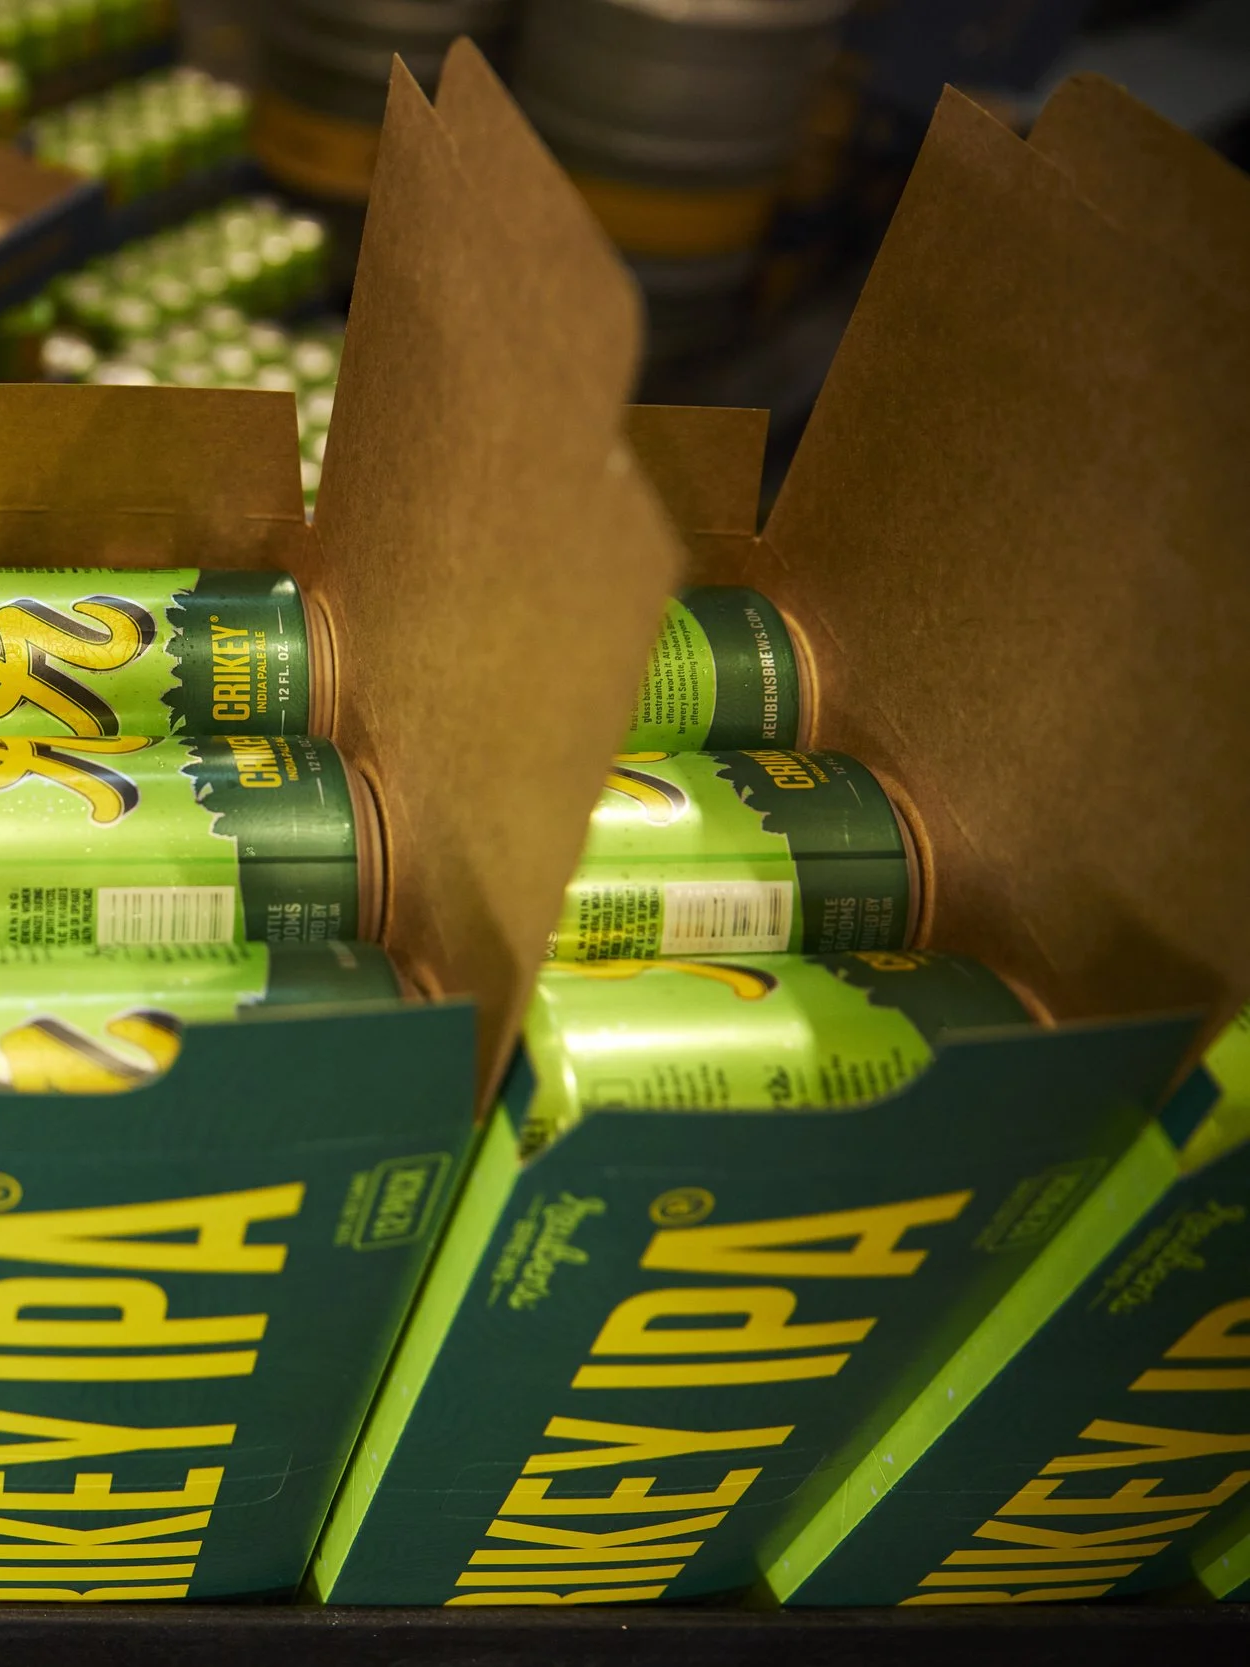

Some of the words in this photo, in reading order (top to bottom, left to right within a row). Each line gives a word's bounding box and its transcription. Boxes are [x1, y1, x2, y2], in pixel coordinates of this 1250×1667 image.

[254, 630, 266, 651] ALE
[277, 640, 289, 662] OZ.
[669, 630, 683, 660] Reuben's
[663, 651, 671, 659] At
[686, 650, 694, 659] for
[255, 652, 268, 680] PALE
[278, 664, 290, 685] FL.
[677, 662, 687, 692] Seattle,
[743, 607, 778, 740] REUBENSBREWS.COM
[666, 670, 674, 692] worth
[689, 661, 699, 700] something
[256, 681, 268, 713] INDIA
[278, 687, 290, 702] 12
[654, 678, 663, 724] constraints,
[642, 702, 652, 723] glass
[666, 701, 674, 723] effort
[677, 702, 689, 734] brewery
[690, 702, 699, 725] offers
[283, 757, 300, 781] INDIA
[307, 760, 322, 773] 12
[311, 903, 327, 919] BY
[865, 897, 880, 912] BY
